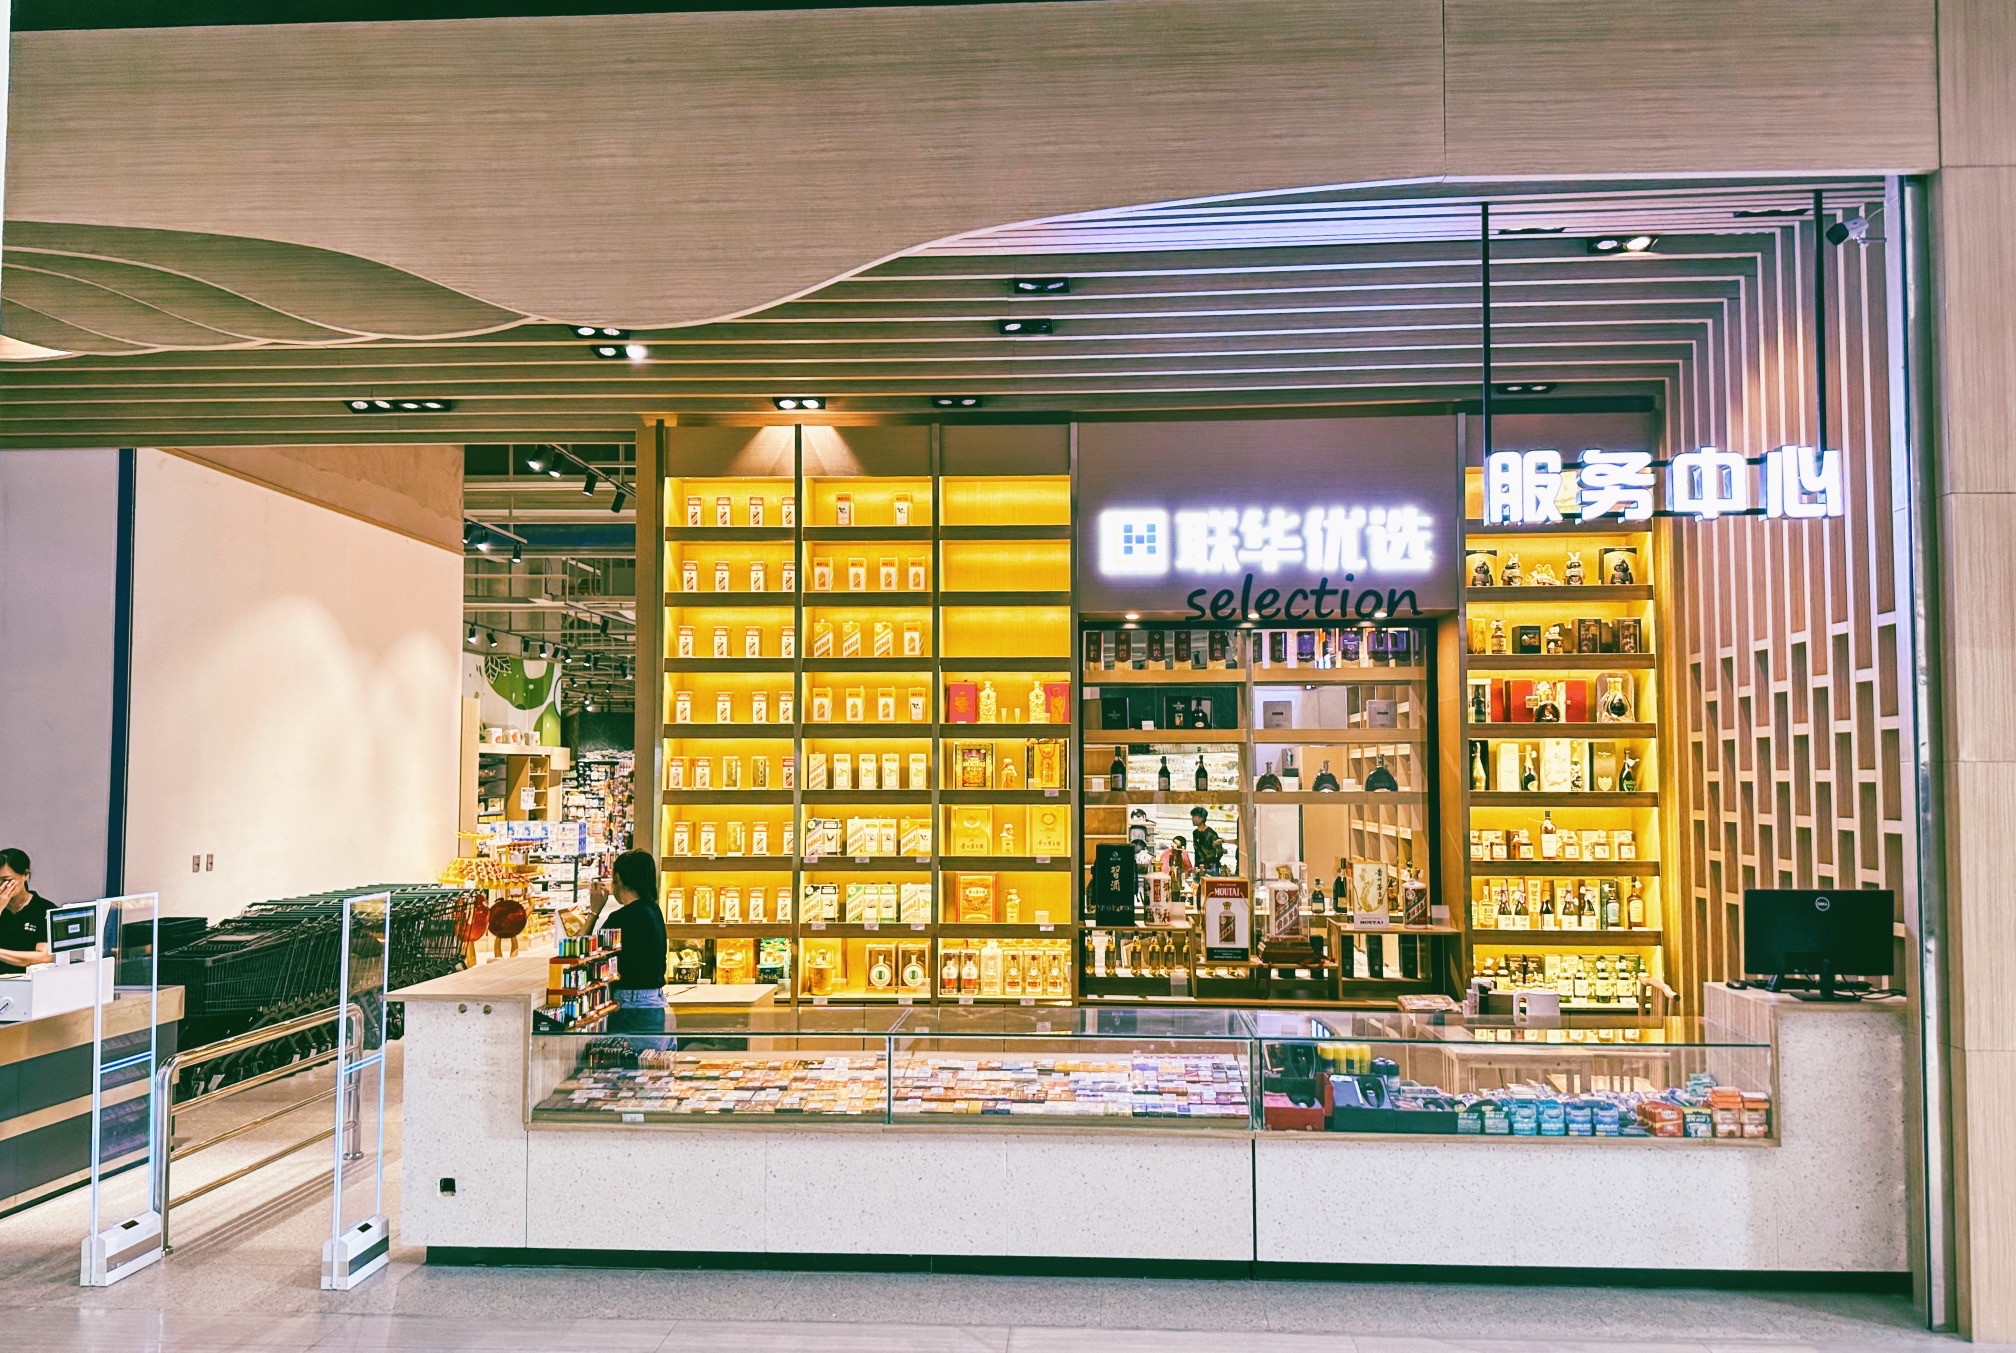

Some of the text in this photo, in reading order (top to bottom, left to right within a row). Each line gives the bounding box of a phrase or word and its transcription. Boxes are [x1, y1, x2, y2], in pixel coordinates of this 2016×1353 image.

[1486, 445, 1844, 524] 服务中心
[1176, 508, 1433, 572] 联华优选
[1185, 573, 1424, 621] selection
[1214, 887, 1240, 896] MOUTAI
